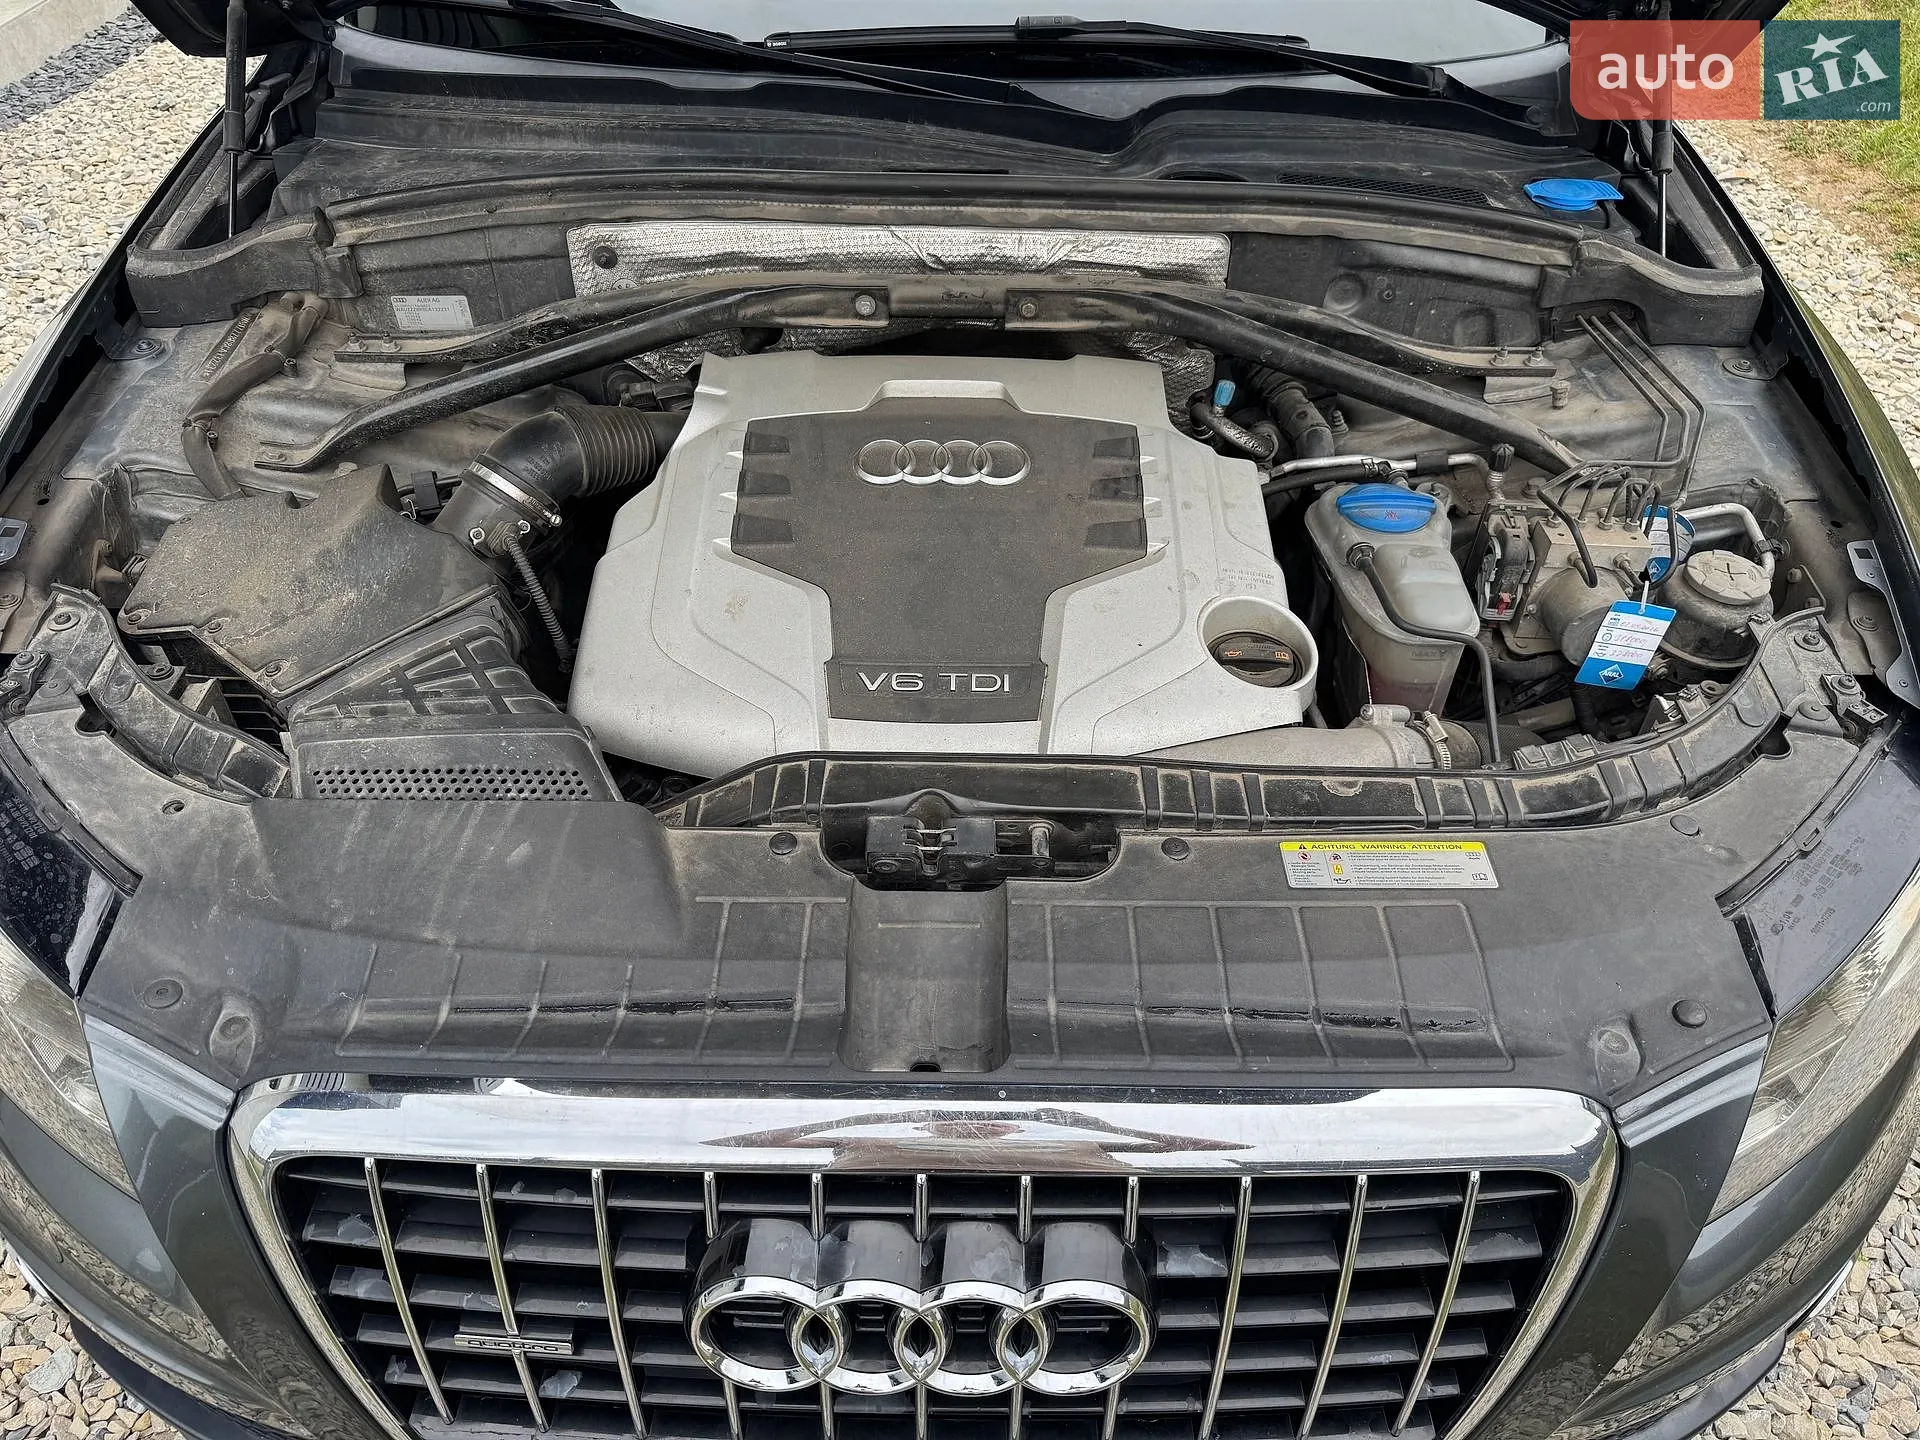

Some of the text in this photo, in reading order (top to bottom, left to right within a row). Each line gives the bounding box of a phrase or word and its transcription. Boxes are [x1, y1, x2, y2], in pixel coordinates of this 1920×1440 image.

[1602, 669, 1619, 677] ARAL
[857, 672, 1010, 692] V6 TDI
[467, 1339, 559, 1351] quattro
